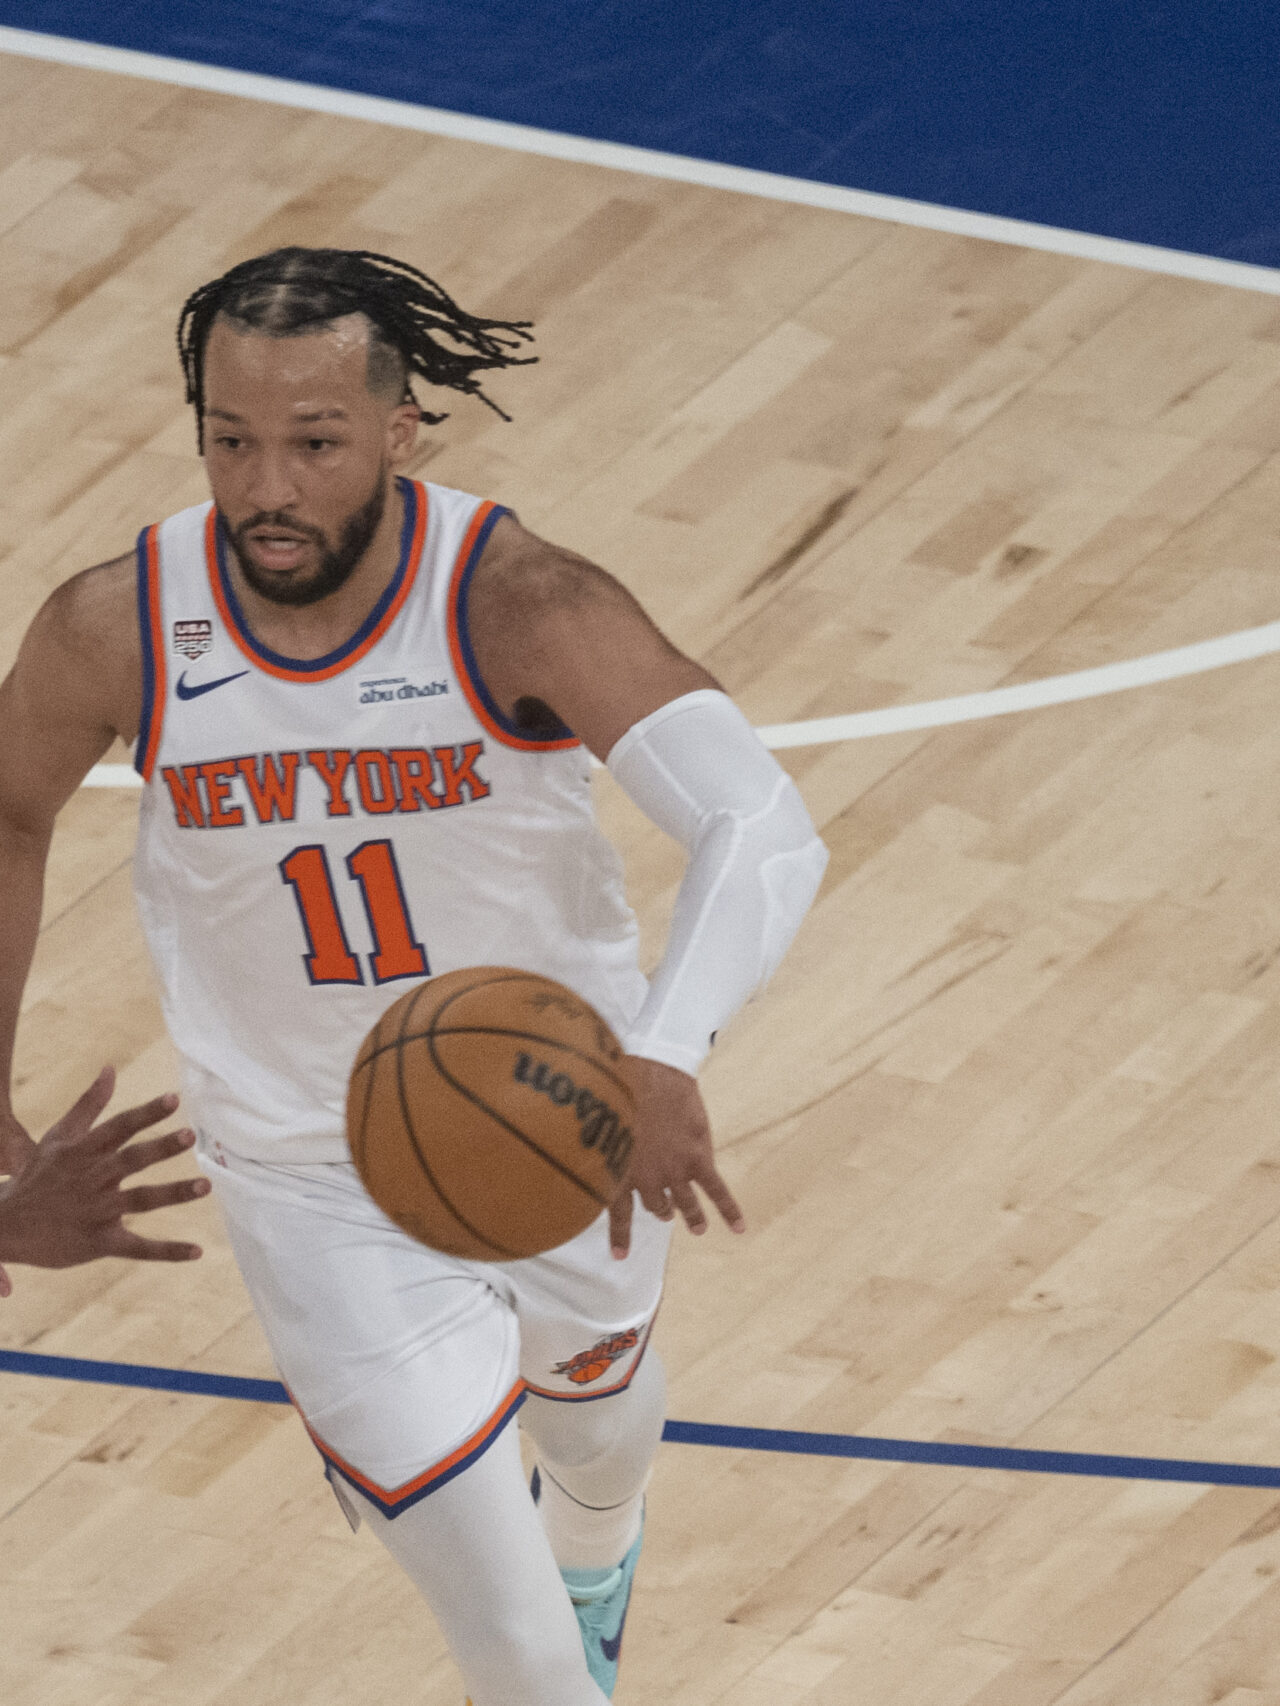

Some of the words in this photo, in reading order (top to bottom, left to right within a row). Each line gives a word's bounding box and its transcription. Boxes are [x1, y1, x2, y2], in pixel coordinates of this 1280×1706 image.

[176, 622, 210, 634] USA
[161, 751, 299, 829] NEW
[308, 740, 491, 817] YORK
[278, 838, 432, 986] 11
